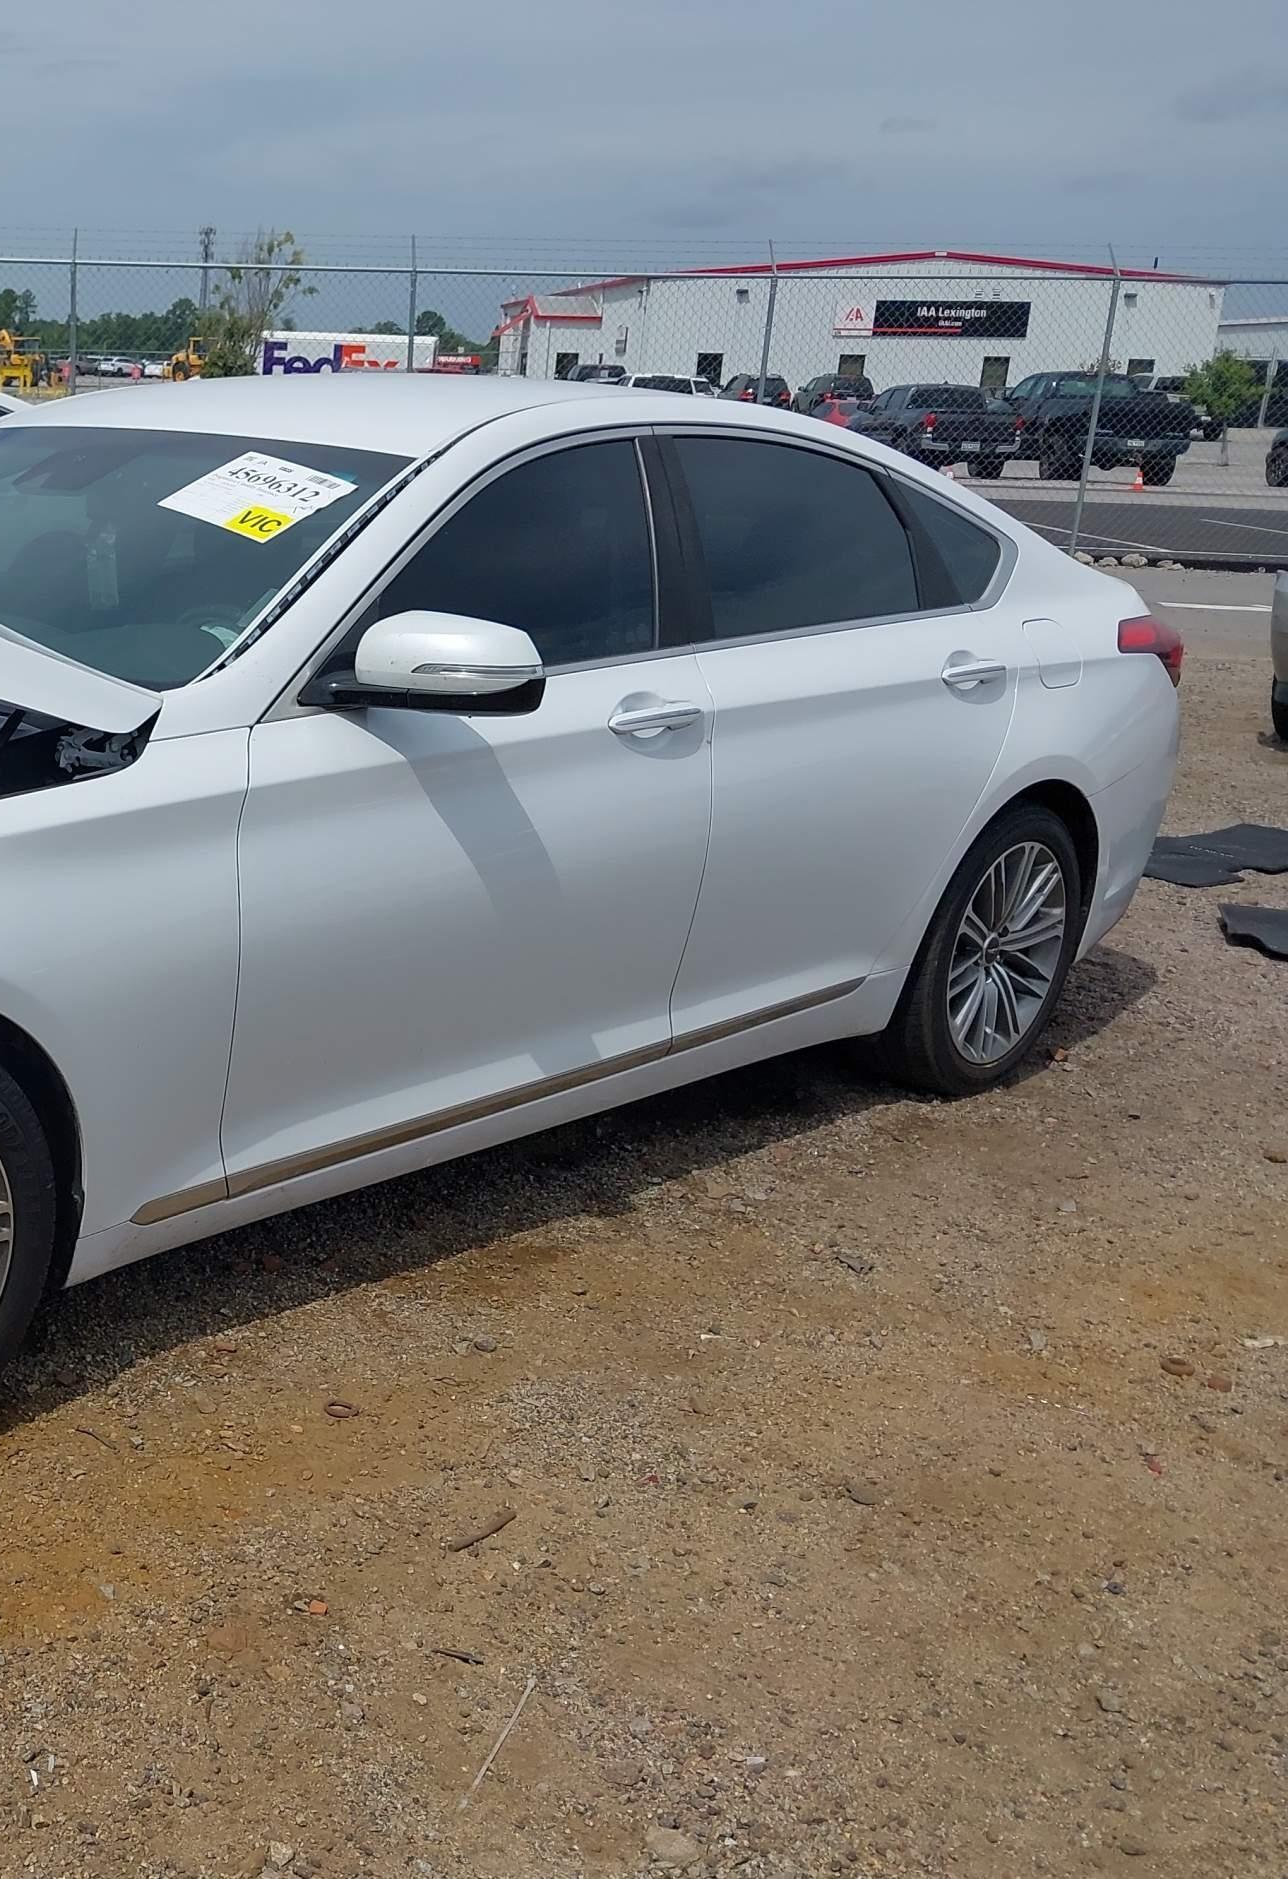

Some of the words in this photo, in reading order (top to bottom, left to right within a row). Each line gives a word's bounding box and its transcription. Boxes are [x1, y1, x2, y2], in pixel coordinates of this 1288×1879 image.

[916, 306, 937, 318] IAA
[938, 306, 988, 320] Lexington
[227, 466, 321, 502] 45696312
[238, 510, 282, 532] VIC
